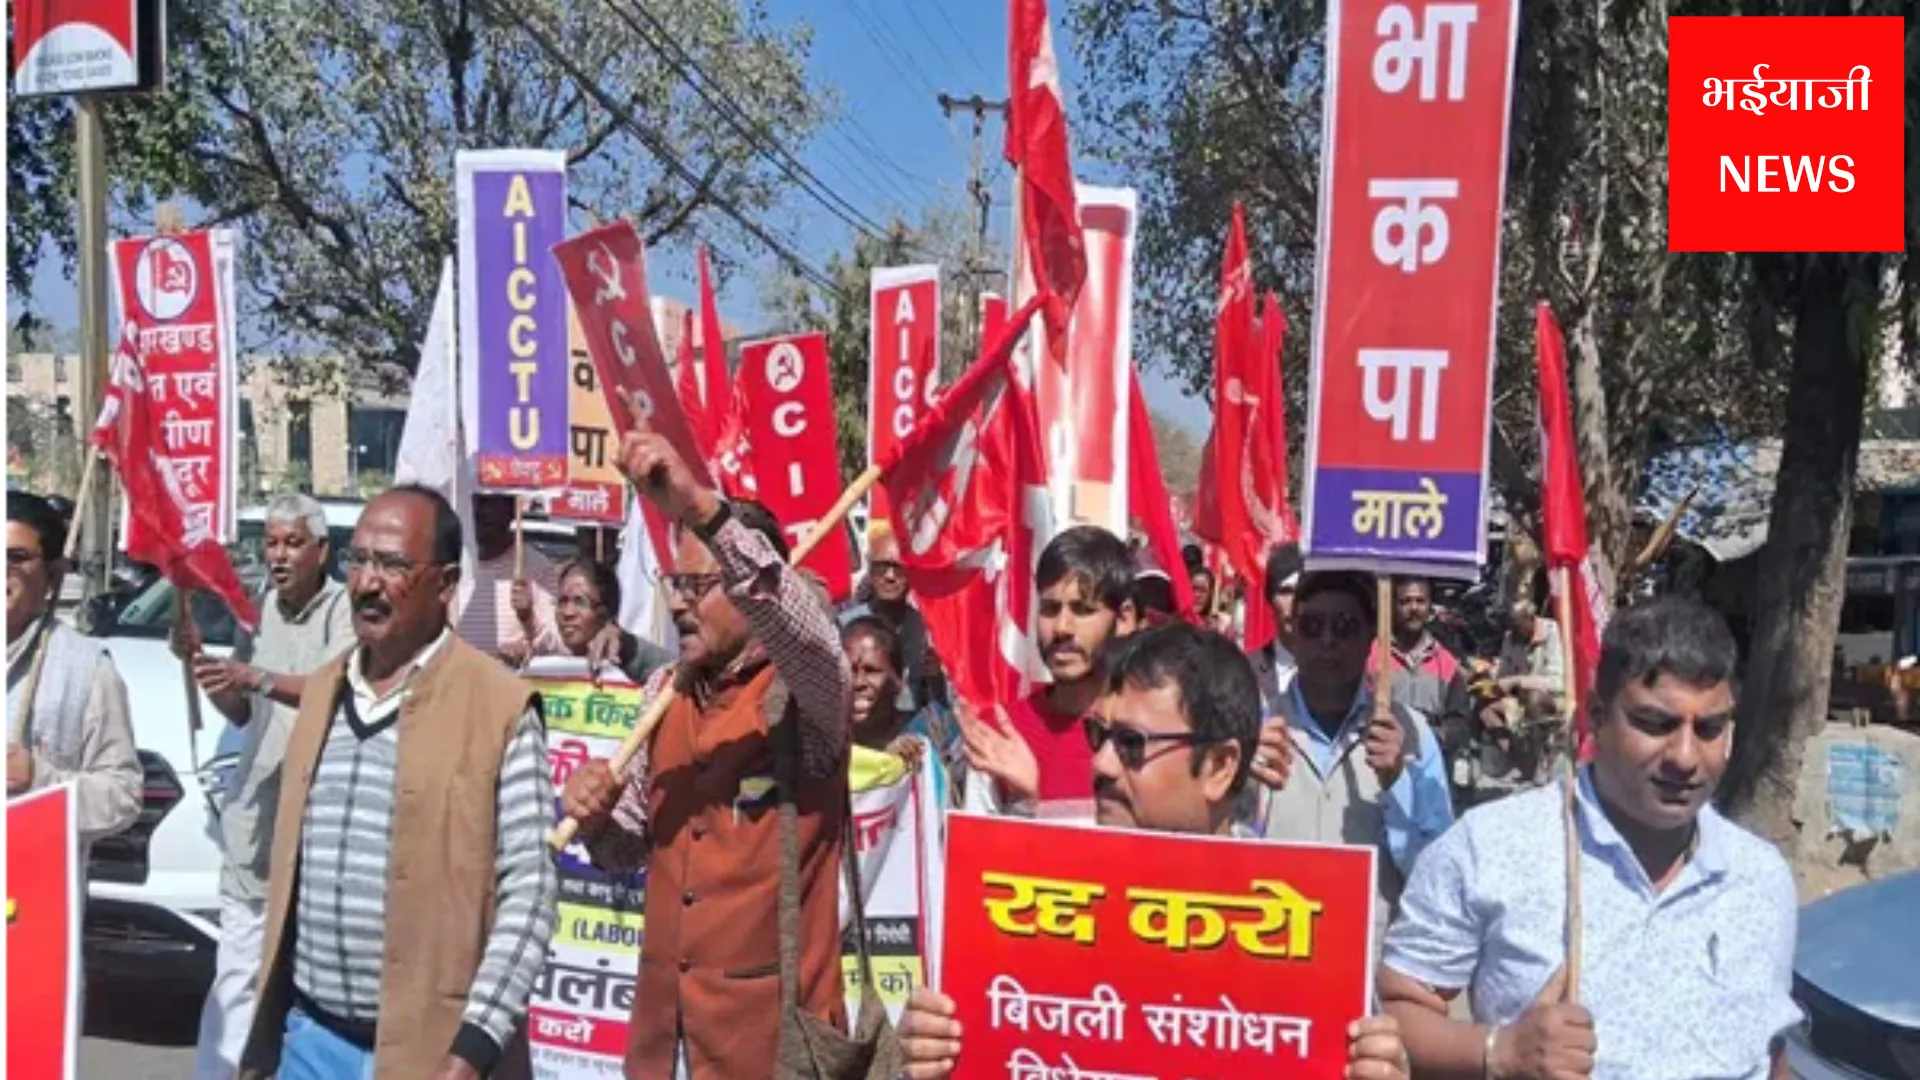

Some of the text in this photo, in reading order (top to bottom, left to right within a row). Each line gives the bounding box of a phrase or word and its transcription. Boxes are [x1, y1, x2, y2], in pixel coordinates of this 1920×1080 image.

[502, 173, 540, 450] AICCTU
[1352, 476, 1449, 540] माले
[982, 871, 1323, 960] रद्द करो
[985, 974, 1313, 1060] बिजली संशोधन
